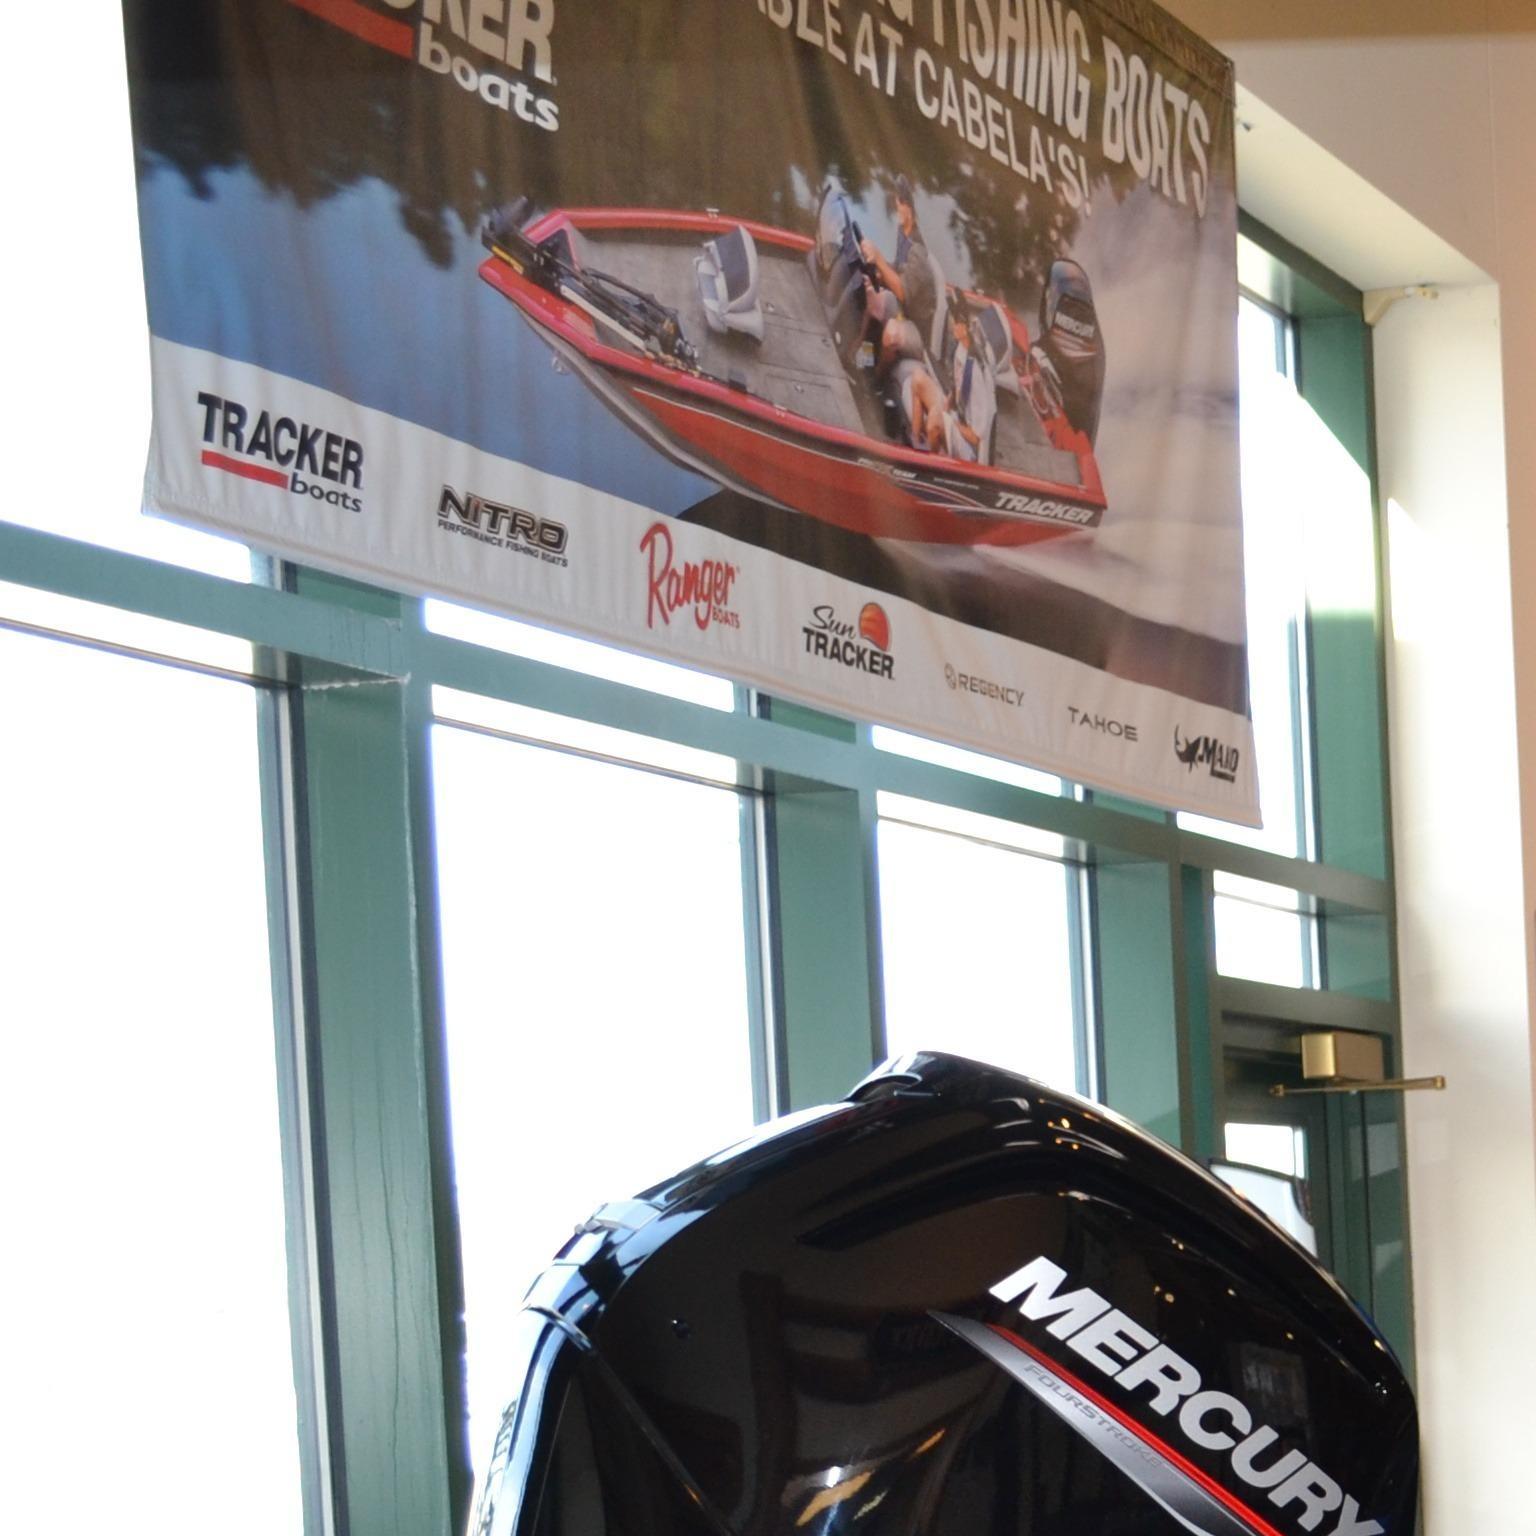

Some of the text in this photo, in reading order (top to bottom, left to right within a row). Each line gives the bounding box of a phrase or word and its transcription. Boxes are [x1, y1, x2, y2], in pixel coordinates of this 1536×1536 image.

[418, 21, 560, 132] boats
[854, 12, 904, 96] AT
[914, 48, 1092, 216] CABELA'S!
[1102, 36, 1209, 218] BOATS
[198, 391, 363, 489] TRACKER
[291, 471, 362, 512] boats
[437, 484, 568, 555] NITRO
[995, 491, 1093, 523] TRACKER
[640, 522, 736, 631] Ranger
[802, 627, 895, 680] TRACKER
[809, 604, 857, 639] Sun
[958, 673, 1025, 707] REGENCY
[1067, 706, 1139, 742] TAHOE
[1024, 1363, 1163, 1469] FOURSTROKE
